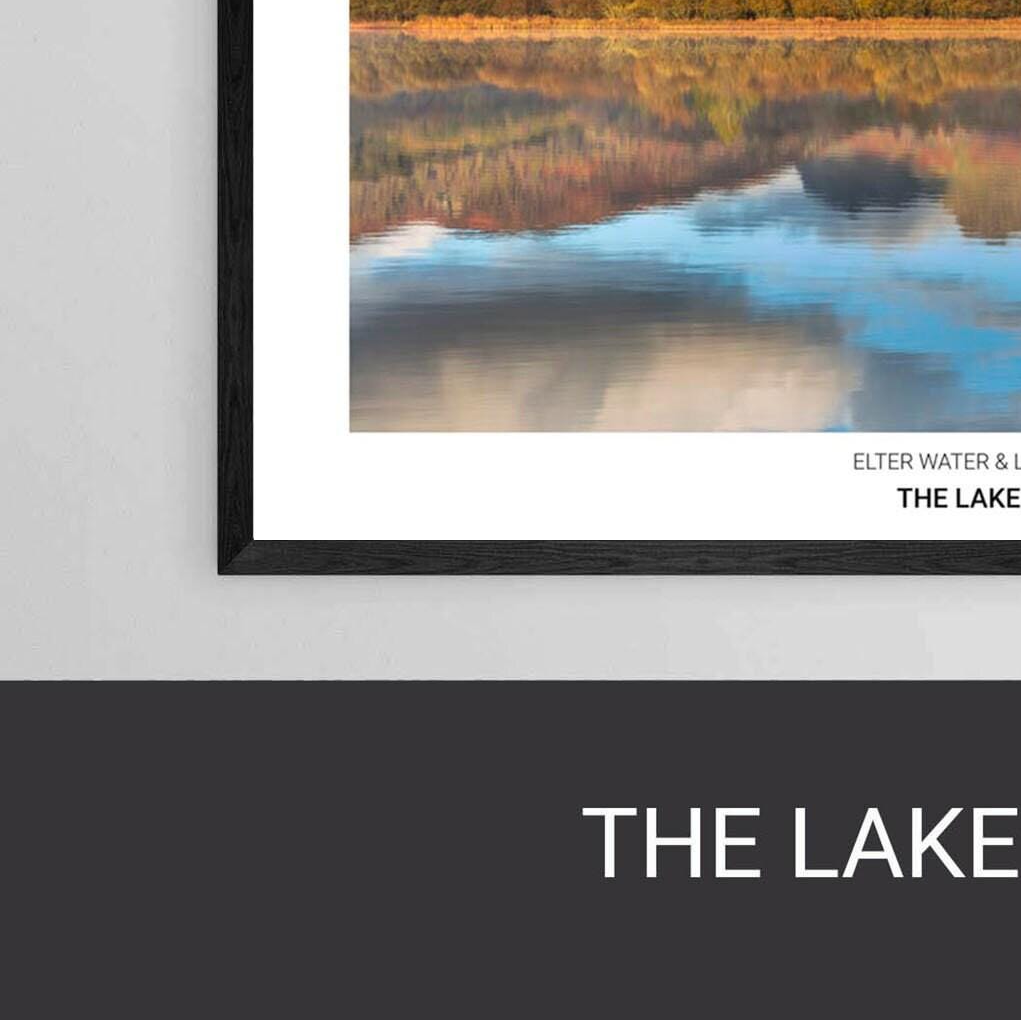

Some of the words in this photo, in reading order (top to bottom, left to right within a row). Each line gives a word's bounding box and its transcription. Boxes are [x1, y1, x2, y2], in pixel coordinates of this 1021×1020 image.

[853, 452, 914, 471] ELTER
[919, 452, 990, 471] WATER
[994, 452, 1009, 471] &
[897, 487, 948, 509] THE
[955, 487, 1021, 509] LAKE
